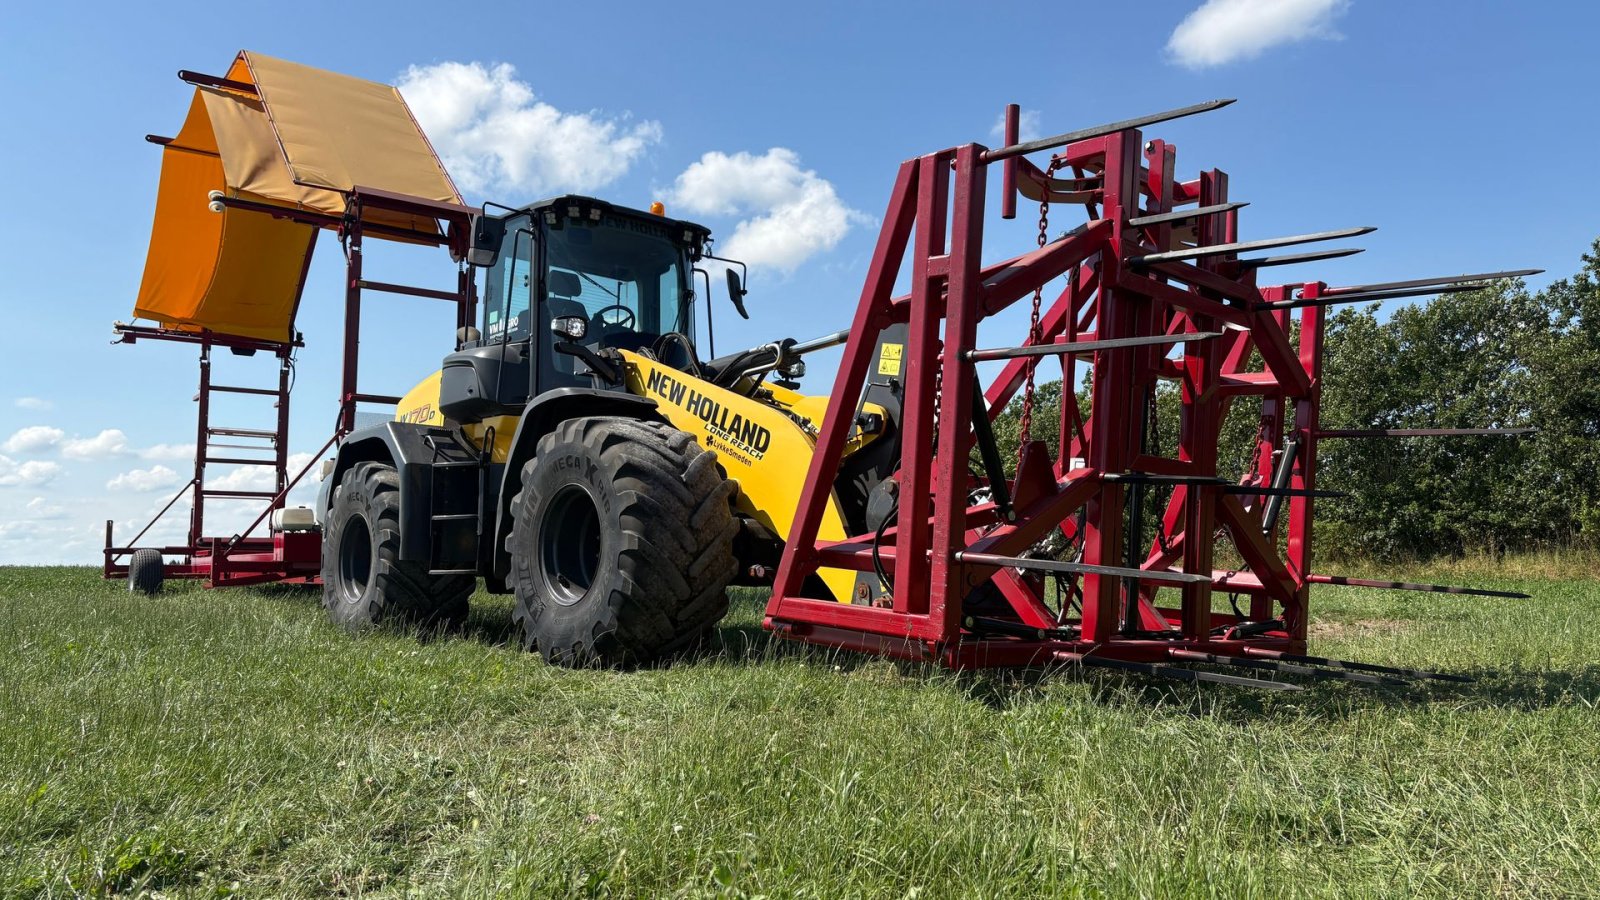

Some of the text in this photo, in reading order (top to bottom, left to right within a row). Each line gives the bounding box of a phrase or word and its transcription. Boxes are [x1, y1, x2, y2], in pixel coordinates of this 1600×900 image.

[647, 367, 771, 454] NEW HOLLAND
[704, 423, 764, 461] LONG REACH
[713, 439, 752, 468] LykkeSmeden
[552, 454, 581, 475] MEGA
[584, 456, 598, 487] X
[519, 485, 541, 600] MICLIN
